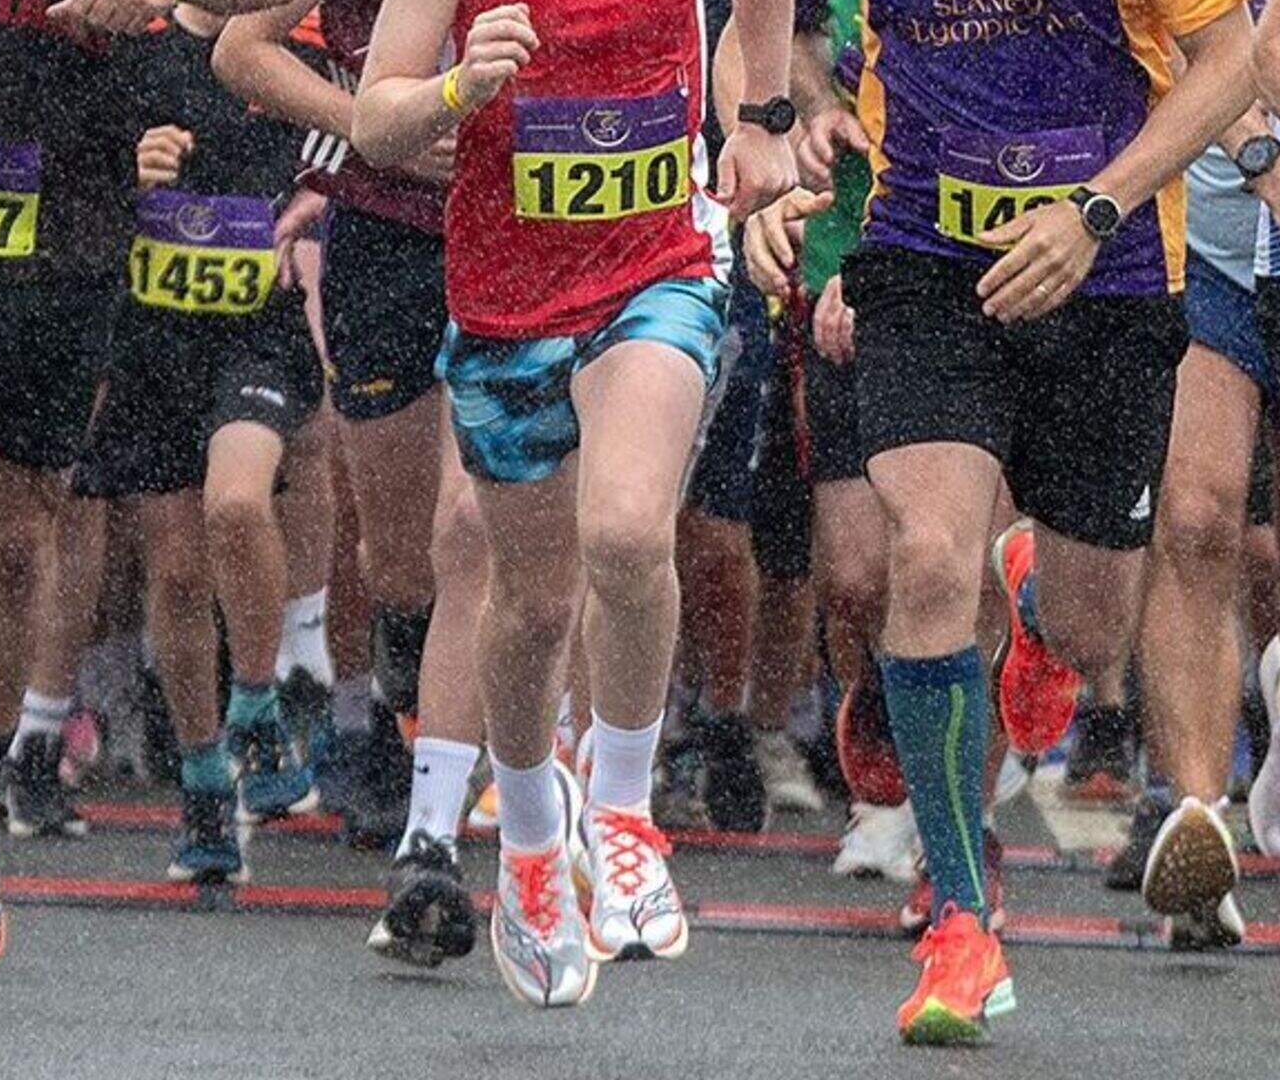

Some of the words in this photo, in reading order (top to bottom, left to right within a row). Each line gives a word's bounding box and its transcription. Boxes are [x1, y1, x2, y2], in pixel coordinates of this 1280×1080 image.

[528, 151, 679, 215] 1210
[950, 188, 1056, 237] 14
[134, 245, 262, 306] 1453
